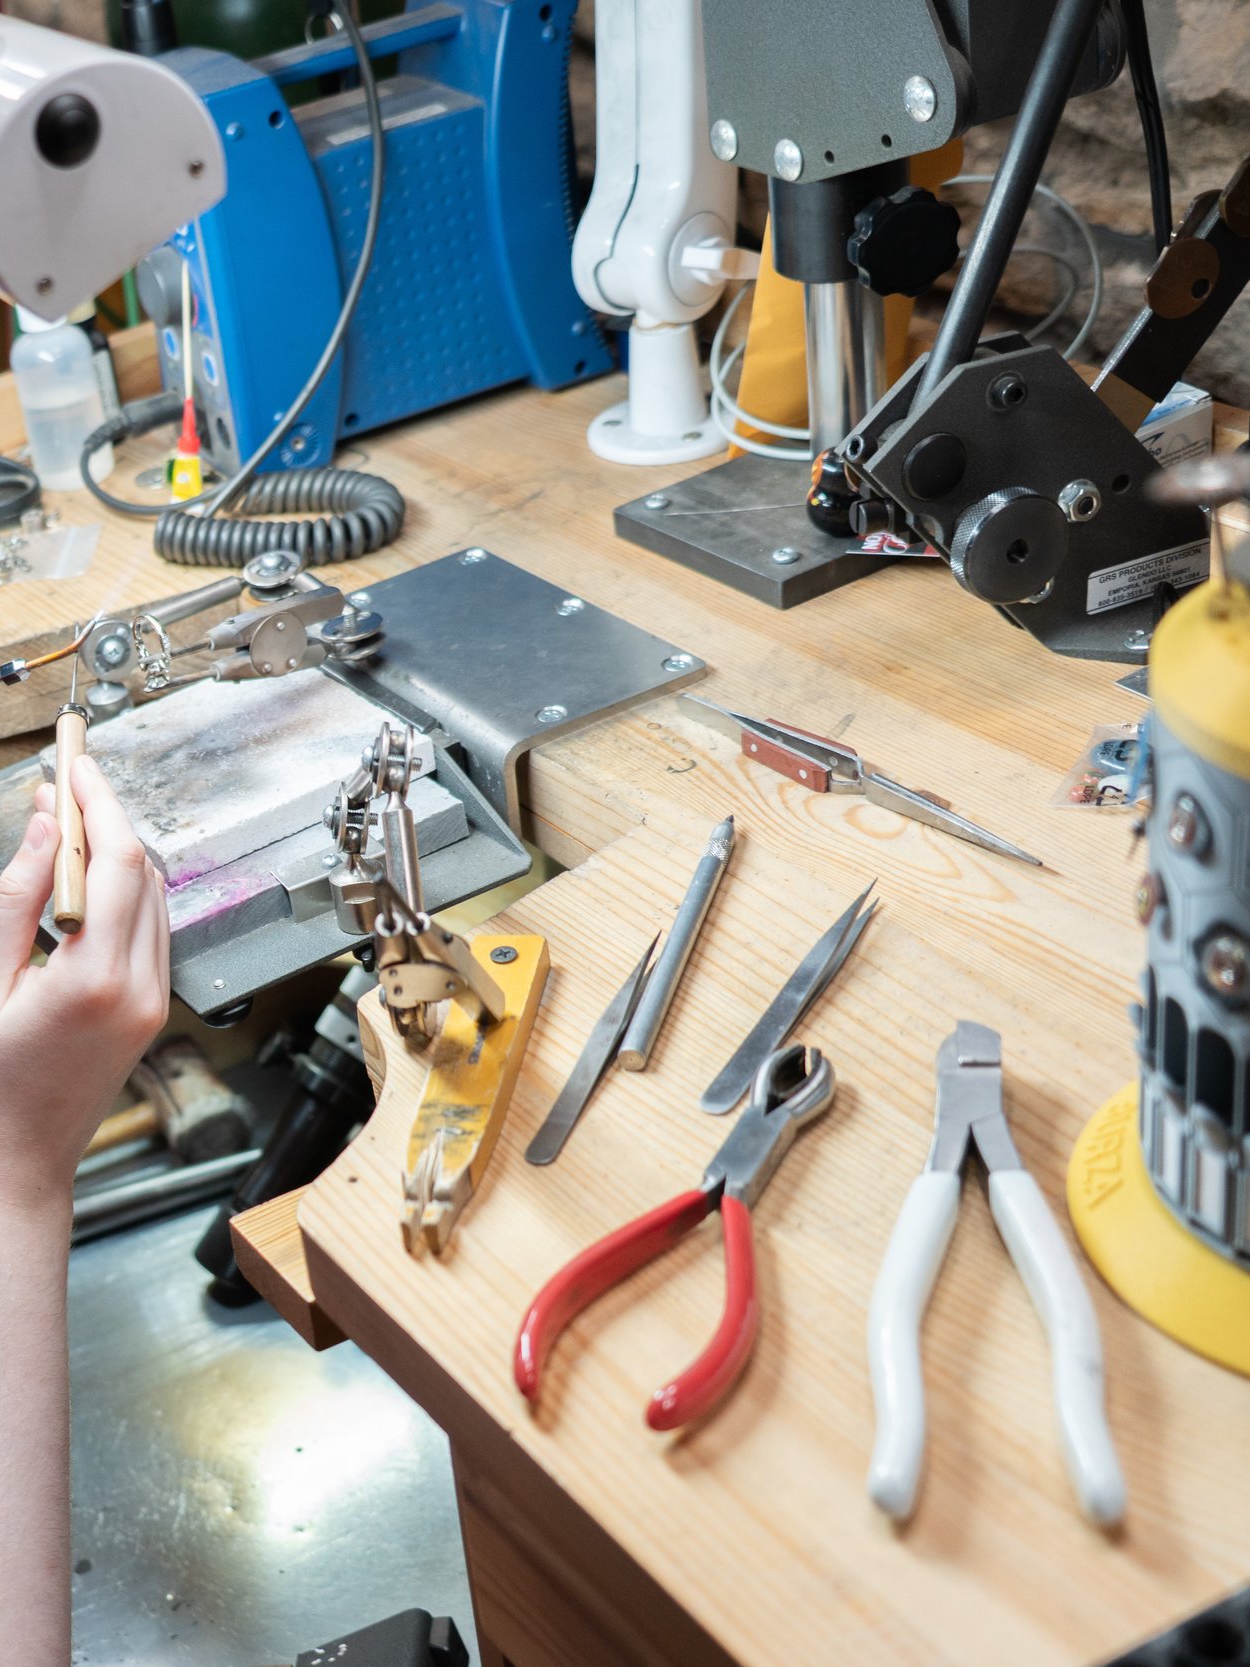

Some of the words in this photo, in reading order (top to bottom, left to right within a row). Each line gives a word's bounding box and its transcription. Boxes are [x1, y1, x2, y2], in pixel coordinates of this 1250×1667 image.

[1098, 572, 1117, 584] GRS
[1118, 559, 1164, 578] PRODUCTS
[1165, 547, 1202, 564] DIVISION
[1142, 573, 1170, 585] KANSAS
[1080, 785, 1095, 804] LDPE
